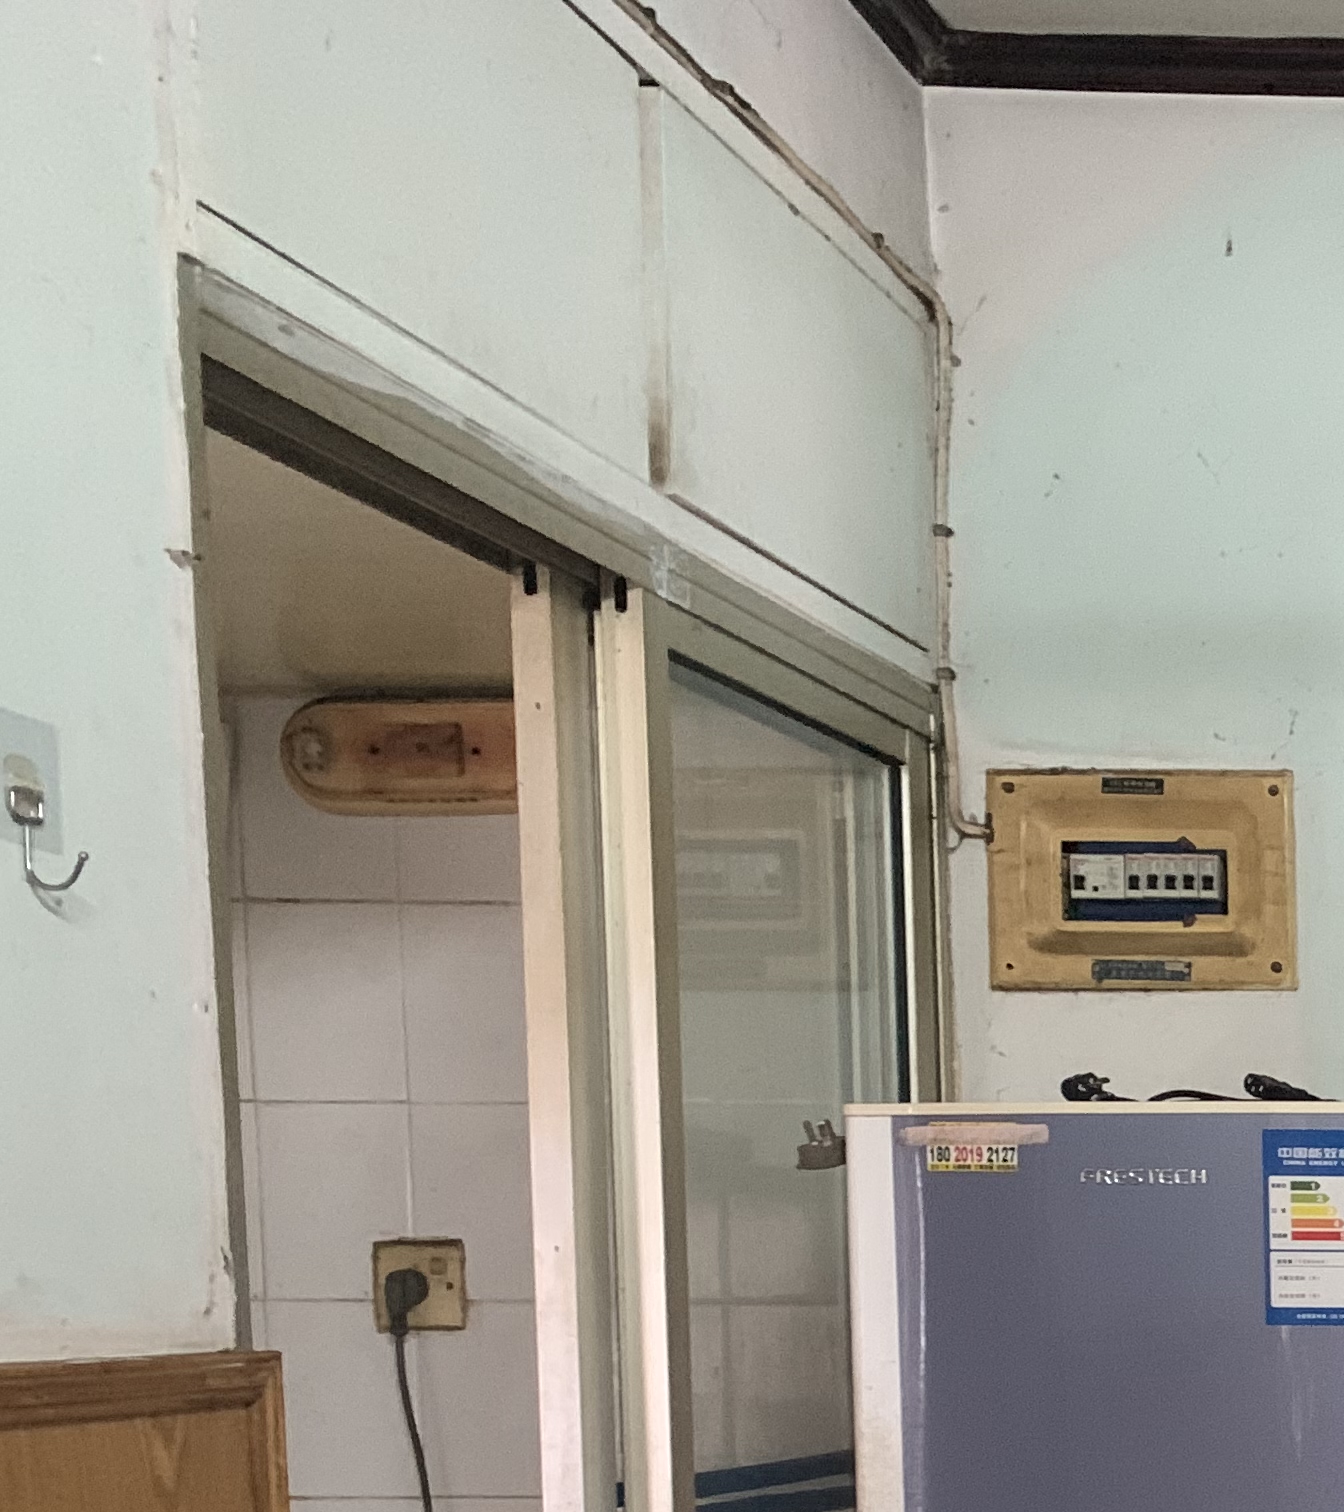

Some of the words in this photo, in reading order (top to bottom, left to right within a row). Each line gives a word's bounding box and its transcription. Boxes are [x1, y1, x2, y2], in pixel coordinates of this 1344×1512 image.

[954, 1146, 983, 1163] 2019
[986, 1146, 1015, 1163] 2127
[1080, 1167, 1207, 1185] FRESTECH
